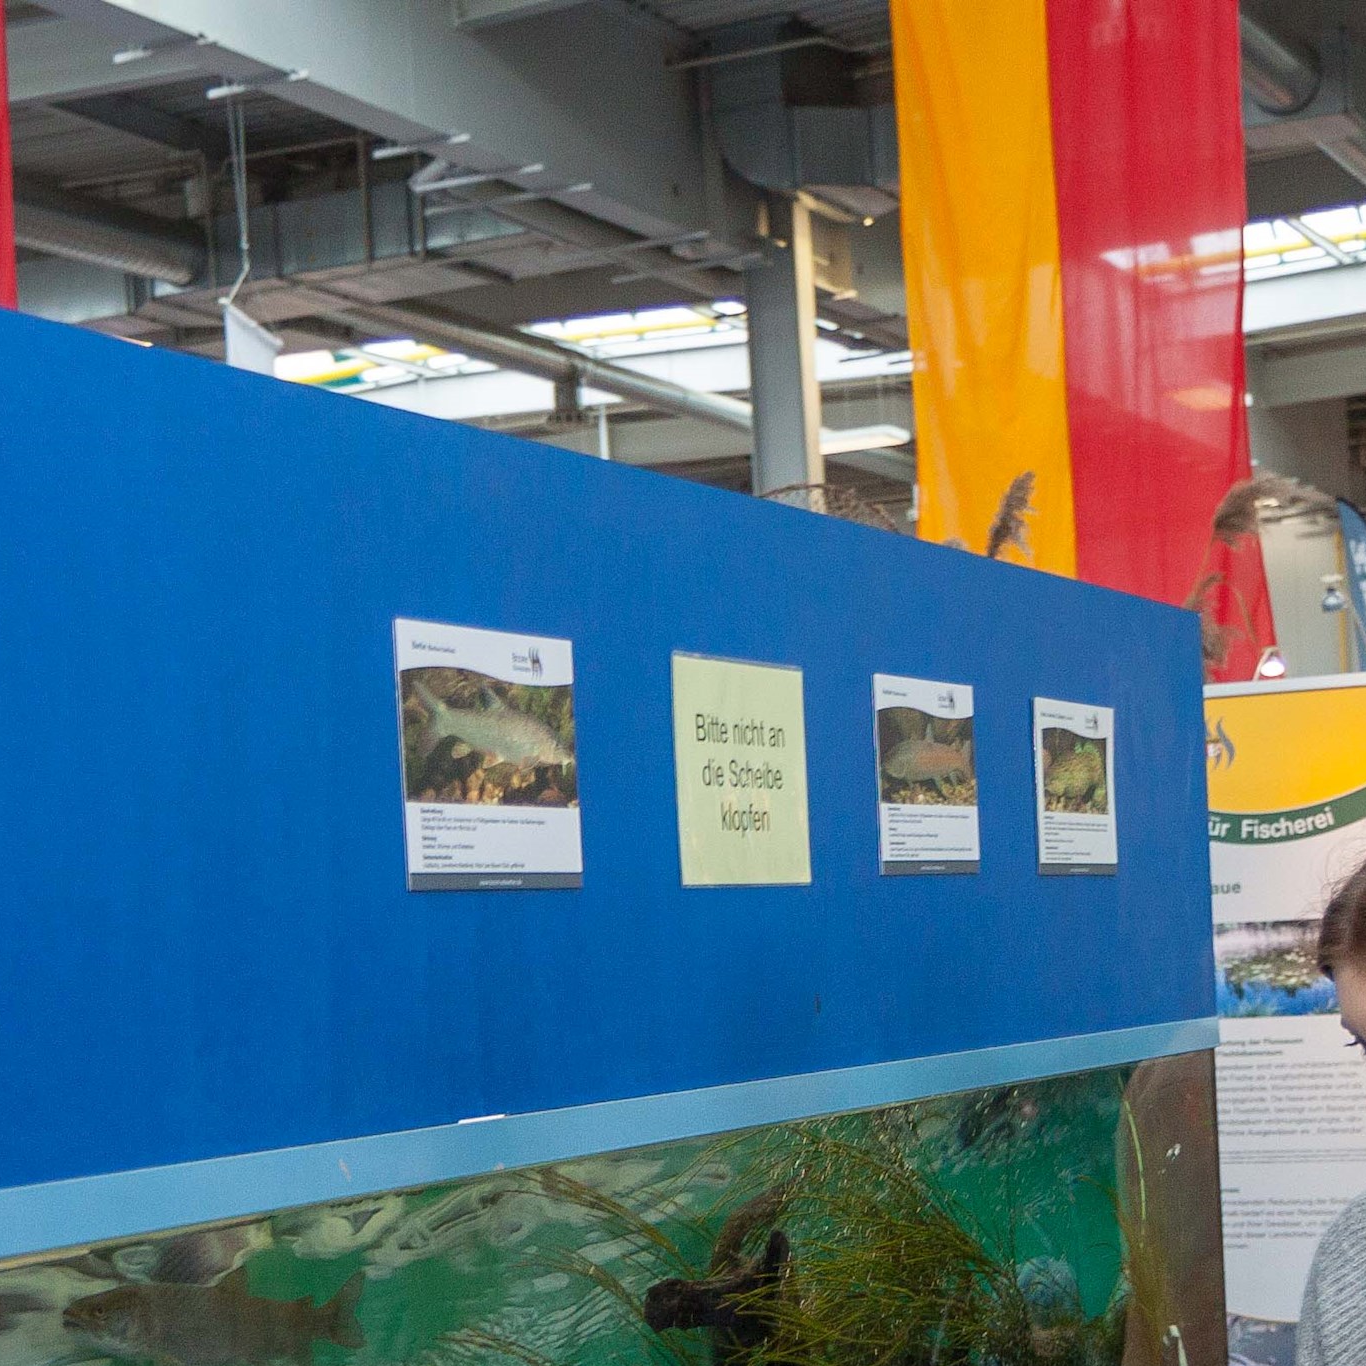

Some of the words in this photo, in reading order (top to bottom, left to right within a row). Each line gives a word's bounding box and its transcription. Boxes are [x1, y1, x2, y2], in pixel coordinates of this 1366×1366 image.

[695, 713, 729, 742] Bitte
[733, 717, 765, 747] nicht
[768, 728, 785, 748] an
[702, 759, 725, 786] die
[728, 758, 783, 790] Scheibe
[720, 804, 771, 838] klopfen
[1208, 816, 1230, 838] ür
[1241, 806, 1335, 840] Fischerei
